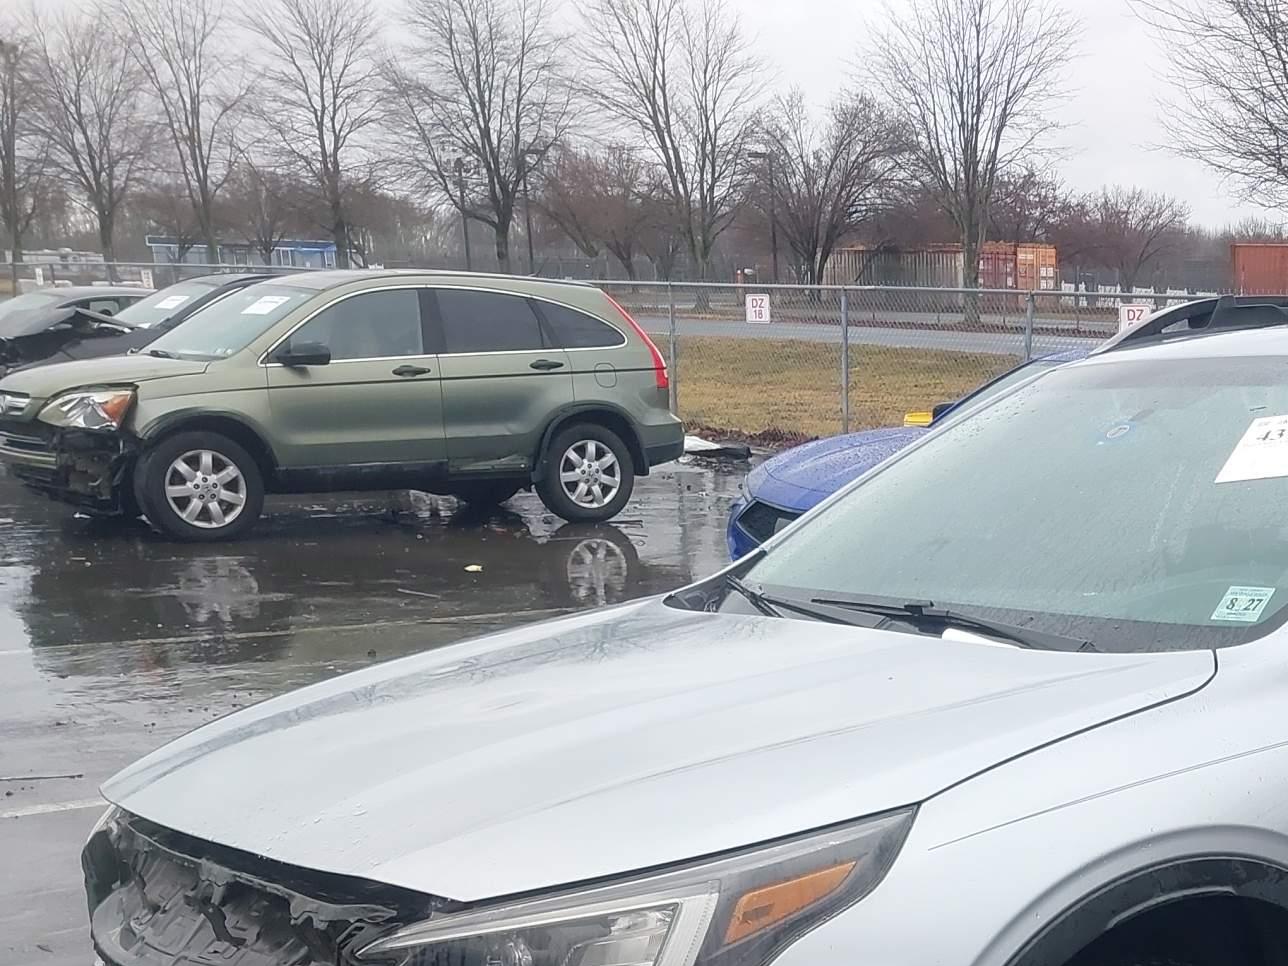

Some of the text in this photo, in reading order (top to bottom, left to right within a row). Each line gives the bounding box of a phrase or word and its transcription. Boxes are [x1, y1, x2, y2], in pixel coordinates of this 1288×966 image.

[752, 298, 765, 309] DZ
[753, 309, 764, 320] 18
[1127, 309, 1144, 321] DZ
[1226, 597, 1265, 611] 8 27
